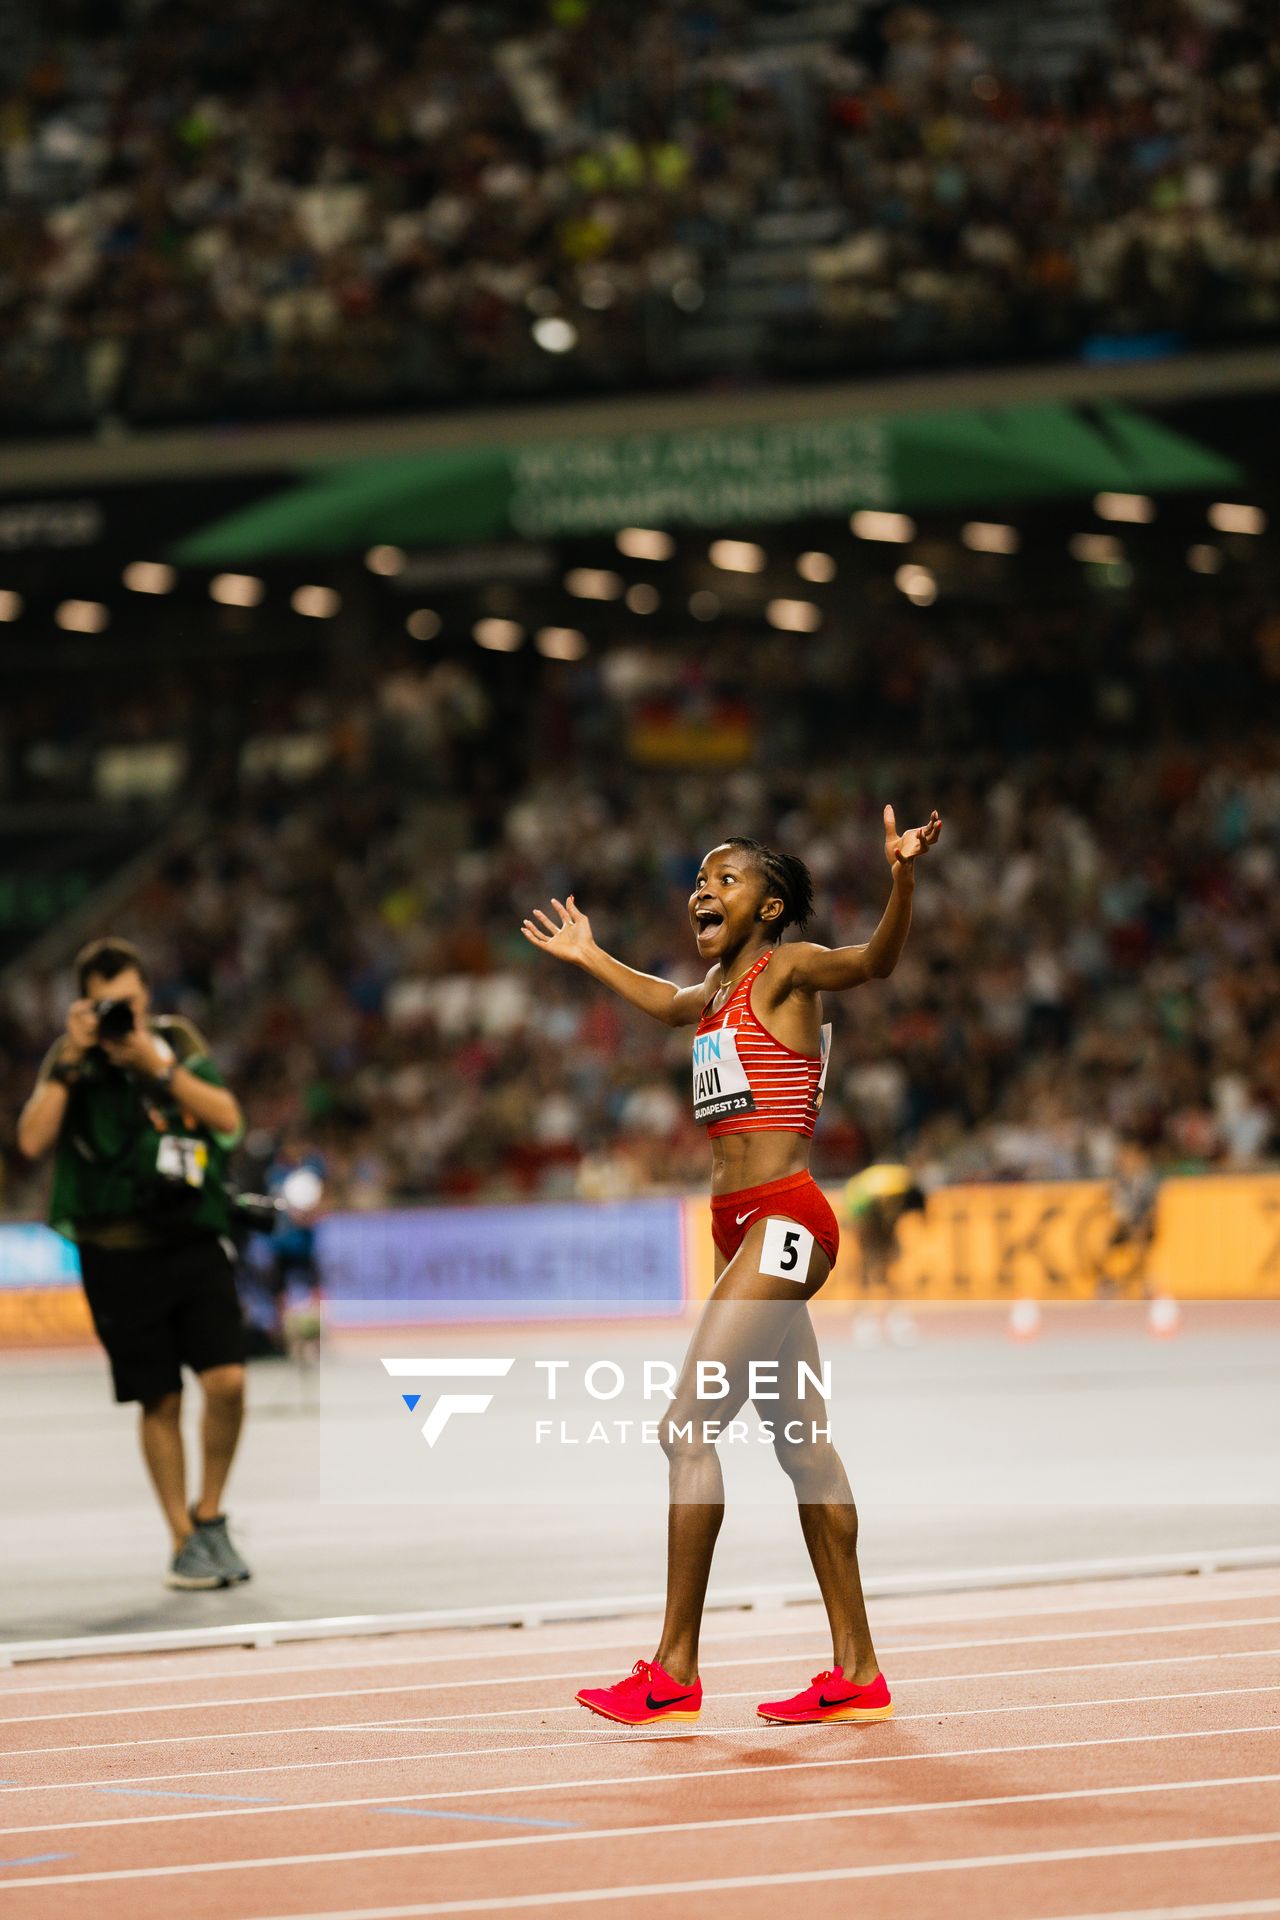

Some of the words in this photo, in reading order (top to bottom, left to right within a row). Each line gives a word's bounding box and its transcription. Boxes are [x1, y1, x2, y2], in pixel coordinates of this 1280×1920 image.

[694, 1067, 722, 1101] YAVI
[695, 1101, 733, 1120] BUDAPEST
[733, 1097, 748, 1110] 23
[780, 1231, 800, 1271] 5
